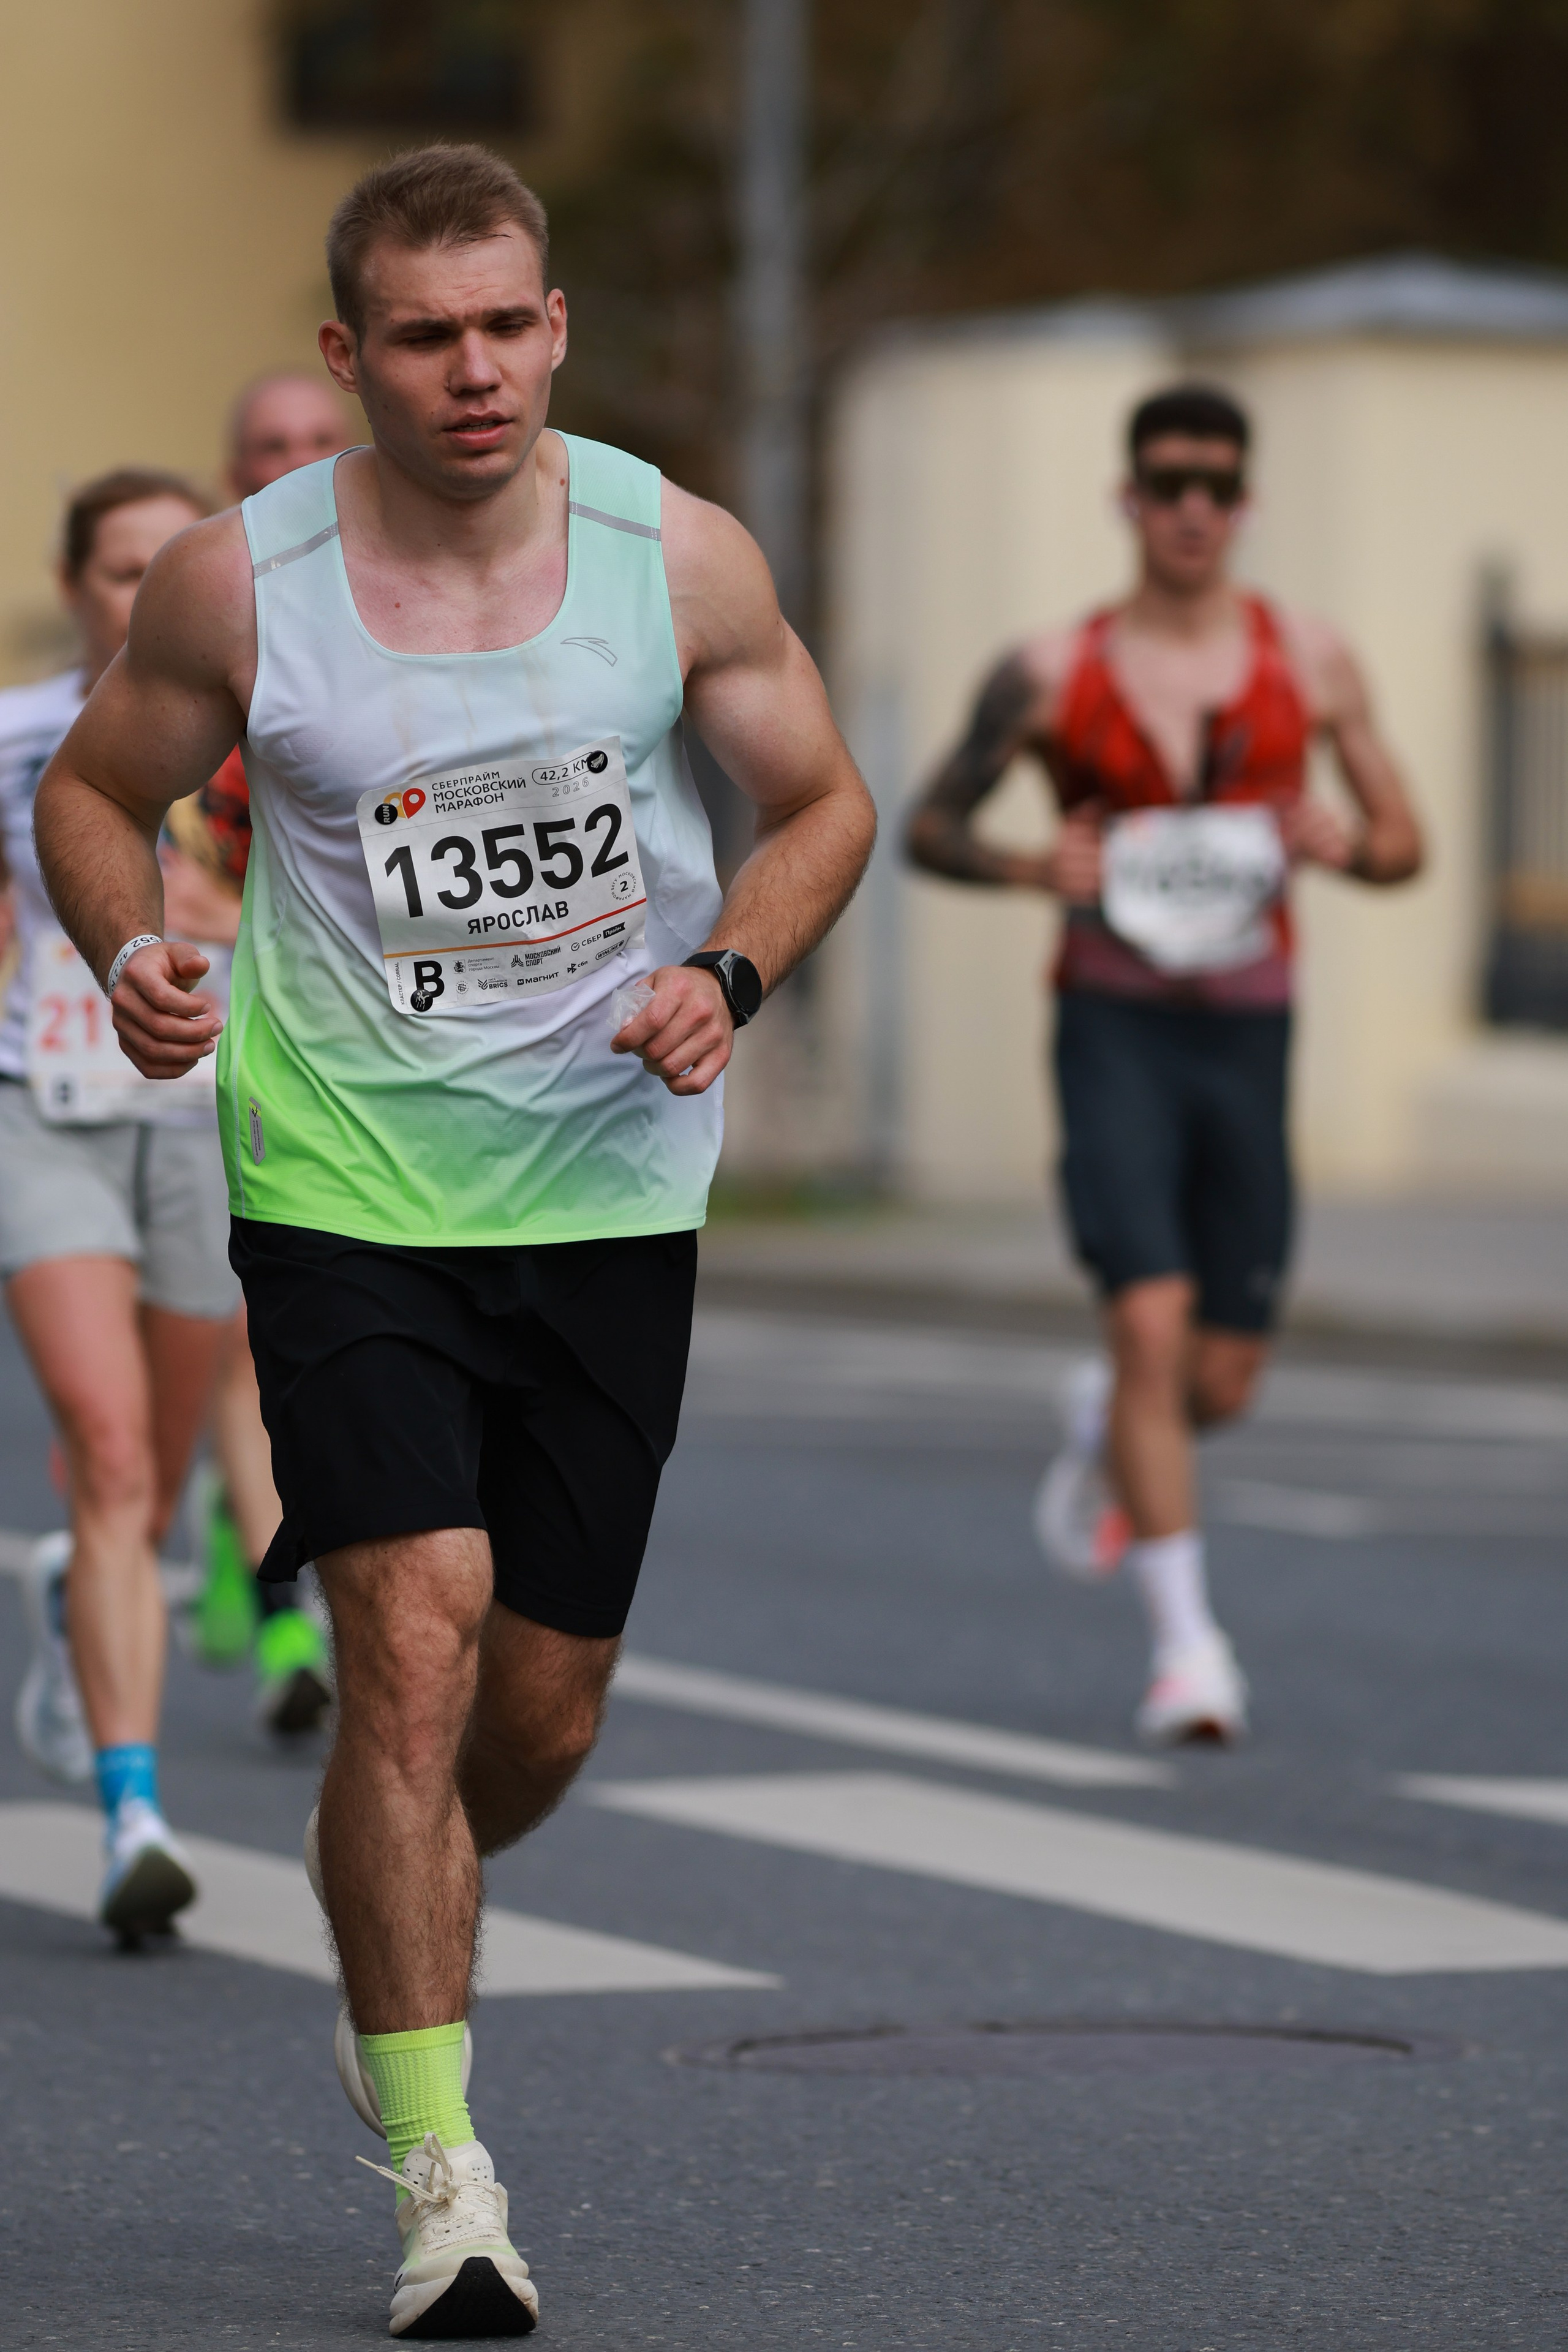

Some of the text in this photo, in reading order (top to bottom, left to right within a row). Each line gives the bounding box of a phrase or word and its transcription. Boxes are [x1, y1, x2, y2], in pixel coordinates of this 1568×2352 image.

[431, 771, 500, 790] СБЕРПРАЙМ
[540, 767, 568, 781] 42,2
[433, 777, 526, 802] МОСКОВСКИЙ
[552, 777, 589, 797] 2026
[435, 793, 504, 813] МАРАФОН
[384, 803, 629, 918] 13552
[620, 880, 628, 892] 2
[467, 900, 569, 934] ЯРОСЛАВ
[130, 937, 162, 948] 552
[581, 926, 622, 946] СБЕР Прайм
[524, 945, 561, 960] МОСКОВСКИЙ
[598, 944, 618, 958] WINLINE
[113, 952, 128, 977] 42,2
[526, 958, 543, 967] СПОРТ
[413, 960, 445, 998] B
